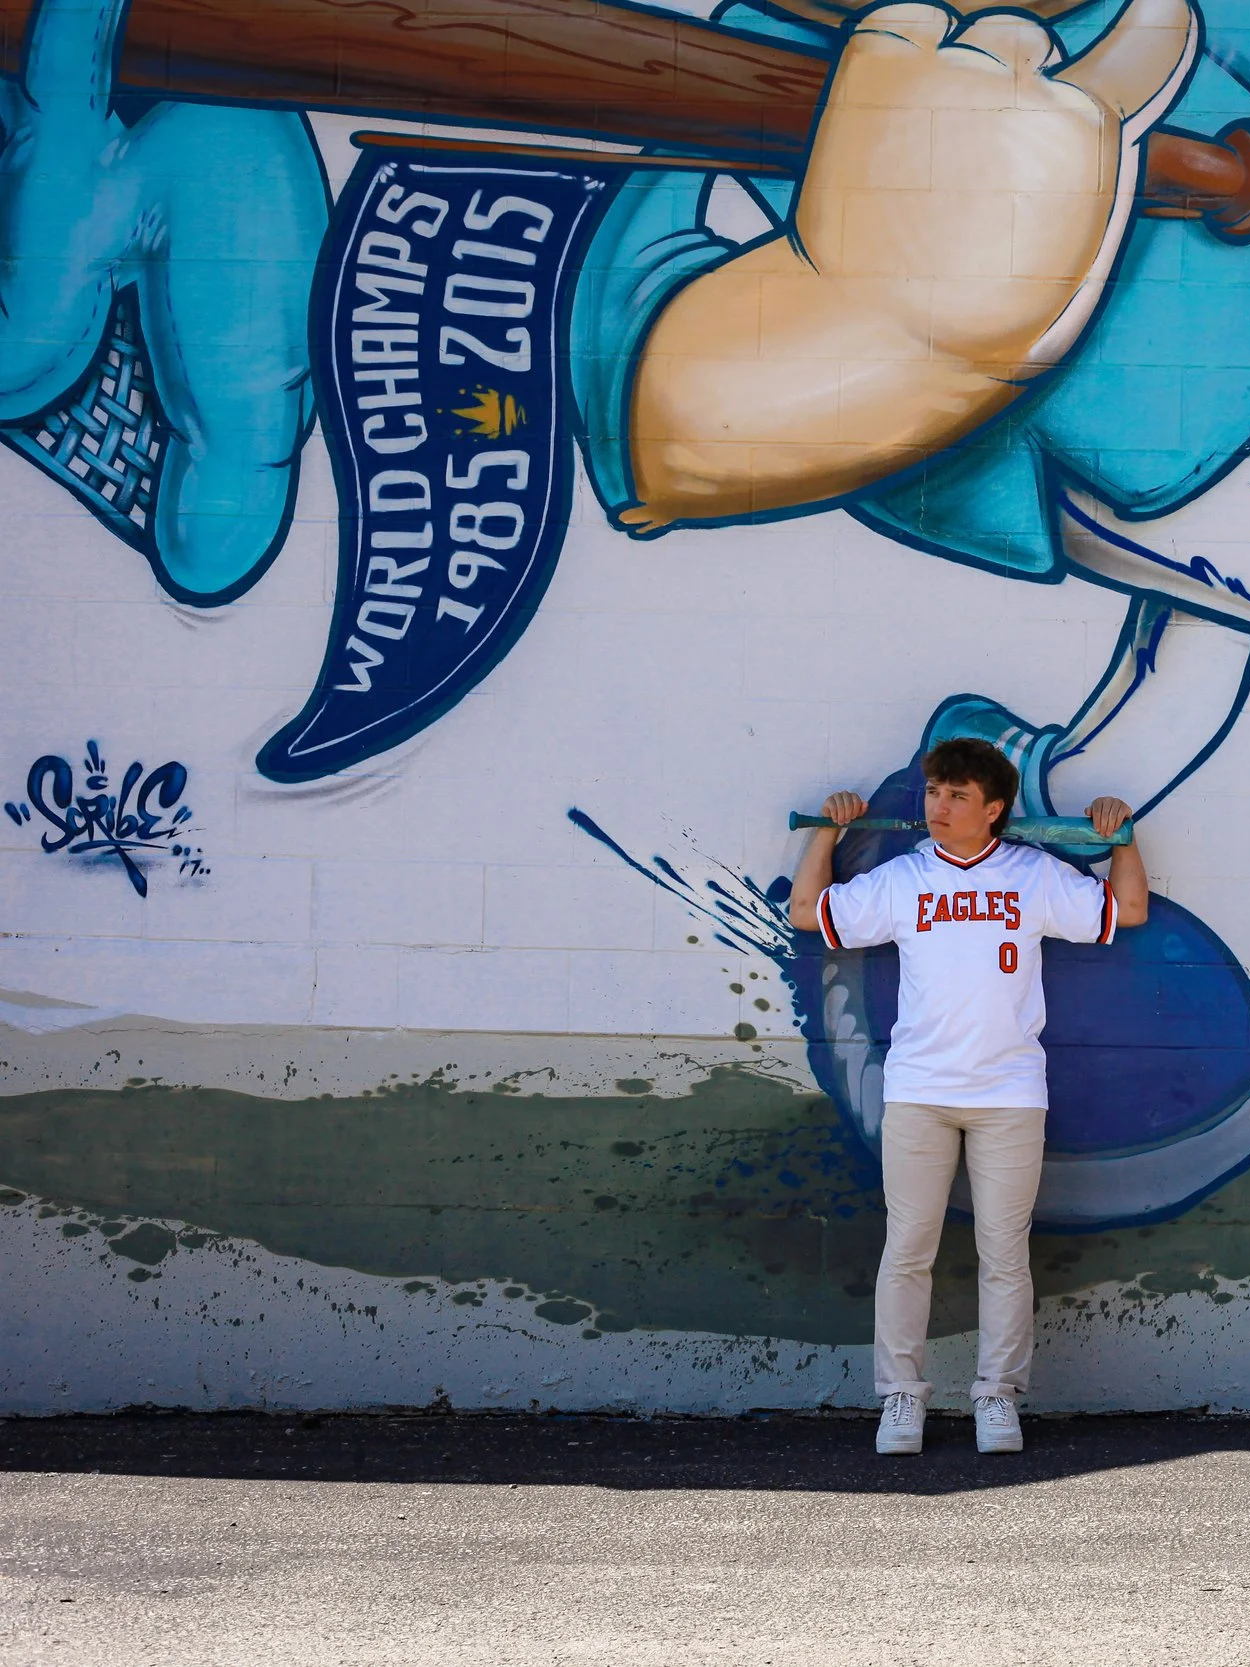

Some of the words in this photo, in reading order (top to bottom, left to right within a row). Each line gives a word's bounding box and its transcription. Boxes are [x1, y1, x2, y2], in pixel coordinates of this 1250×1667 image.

[351, 185, 450, 454] CHAMPS
[438, 189, 554, 372] 2015
[336, 469, 434, 692] WORLD
[436, 450, 530, 634] 1985
[916, 890, 1021, 932] EAGLES
[998, 941, 1019, 974] 0
